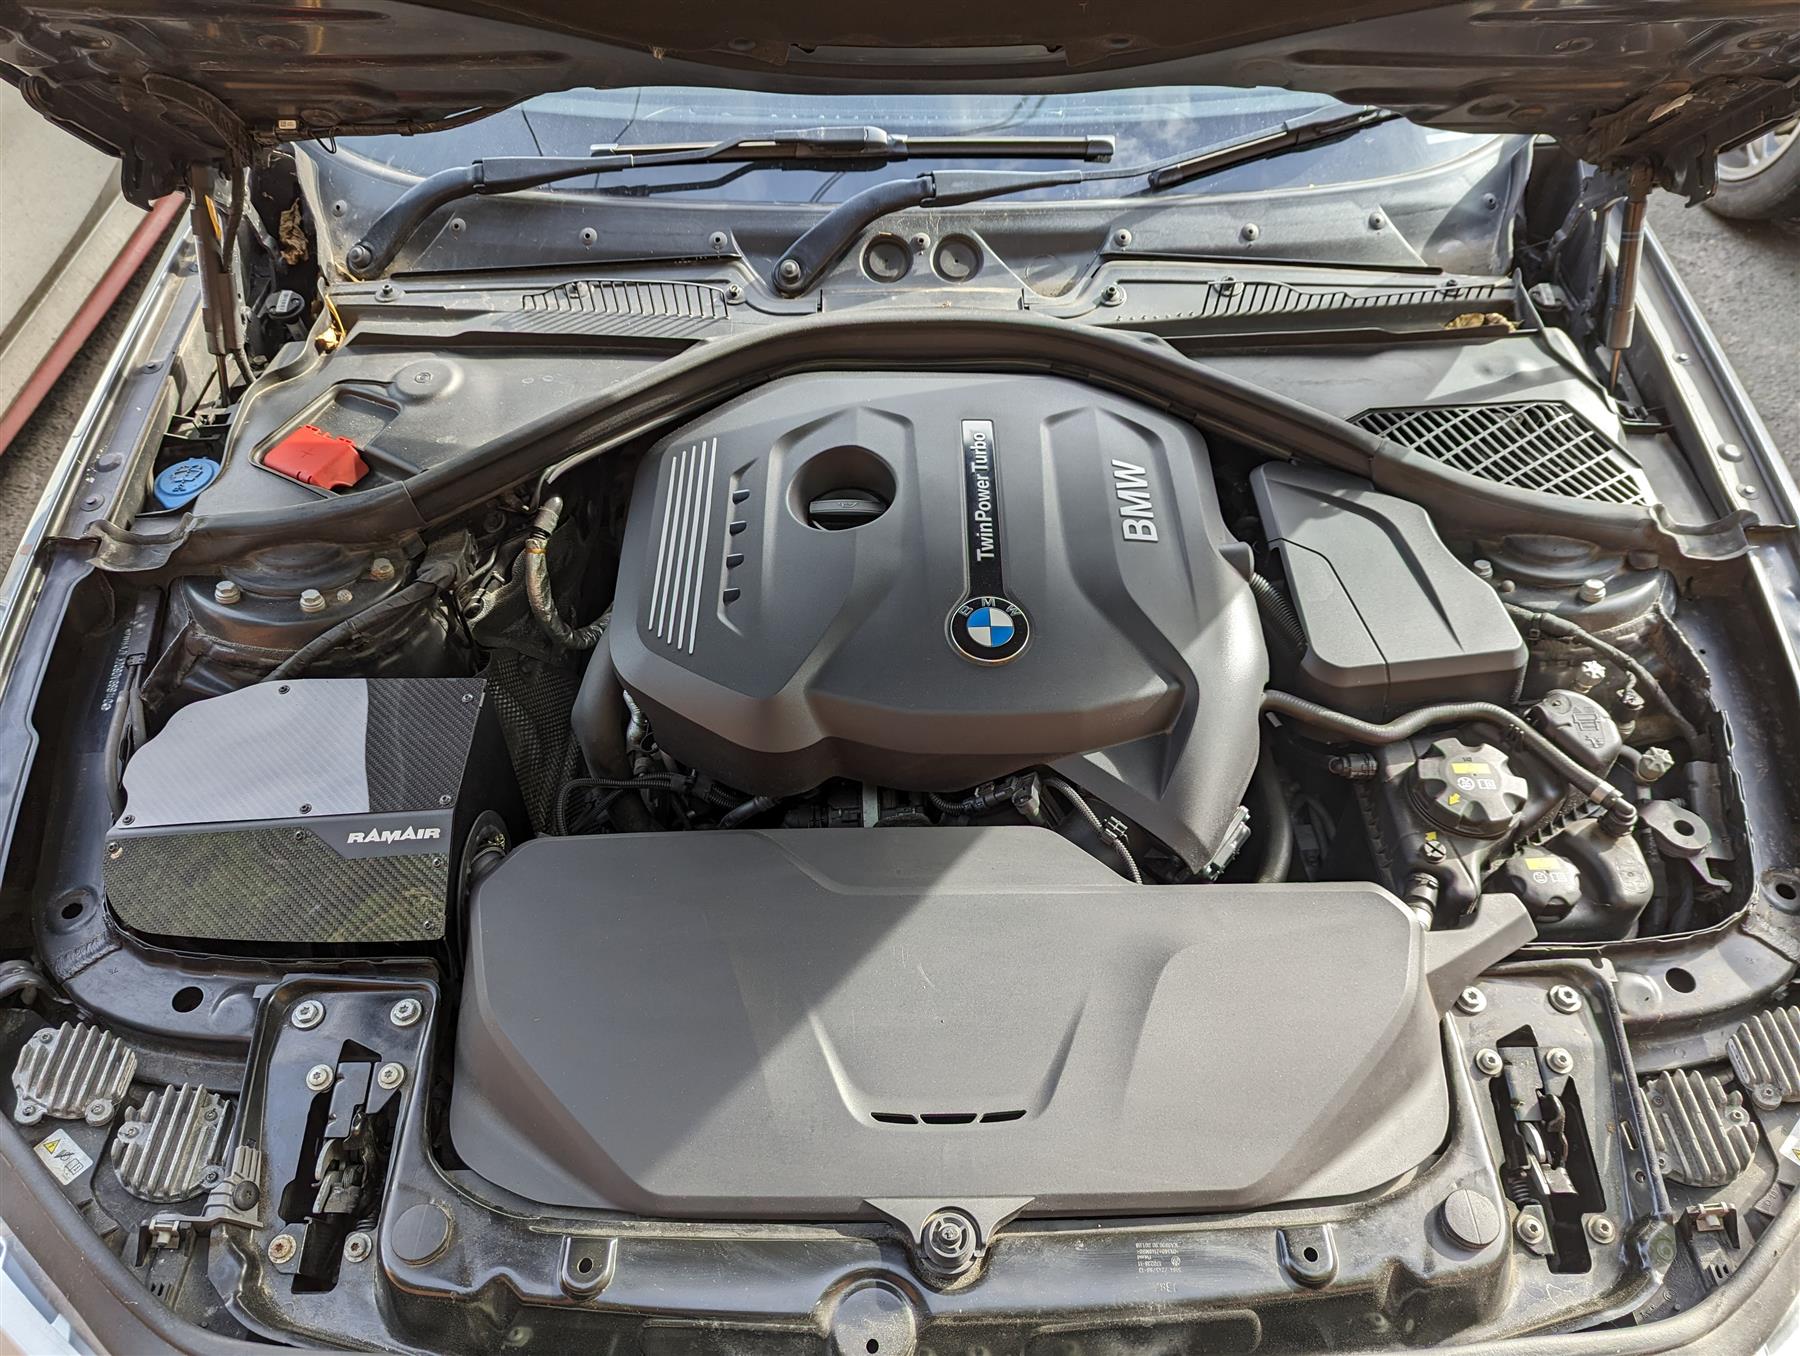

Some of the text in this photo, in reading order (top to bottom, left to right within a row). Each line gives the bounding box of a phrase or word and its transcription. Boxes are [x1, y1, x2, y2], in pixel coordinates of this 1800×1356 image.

[969, 431, 995, 562] TwinPower Turbo
[1111, 459, 1159, 543] BMW
[958, 597, 1022, 617] BMW
[346, 825, 441, 845] RAMAIR
